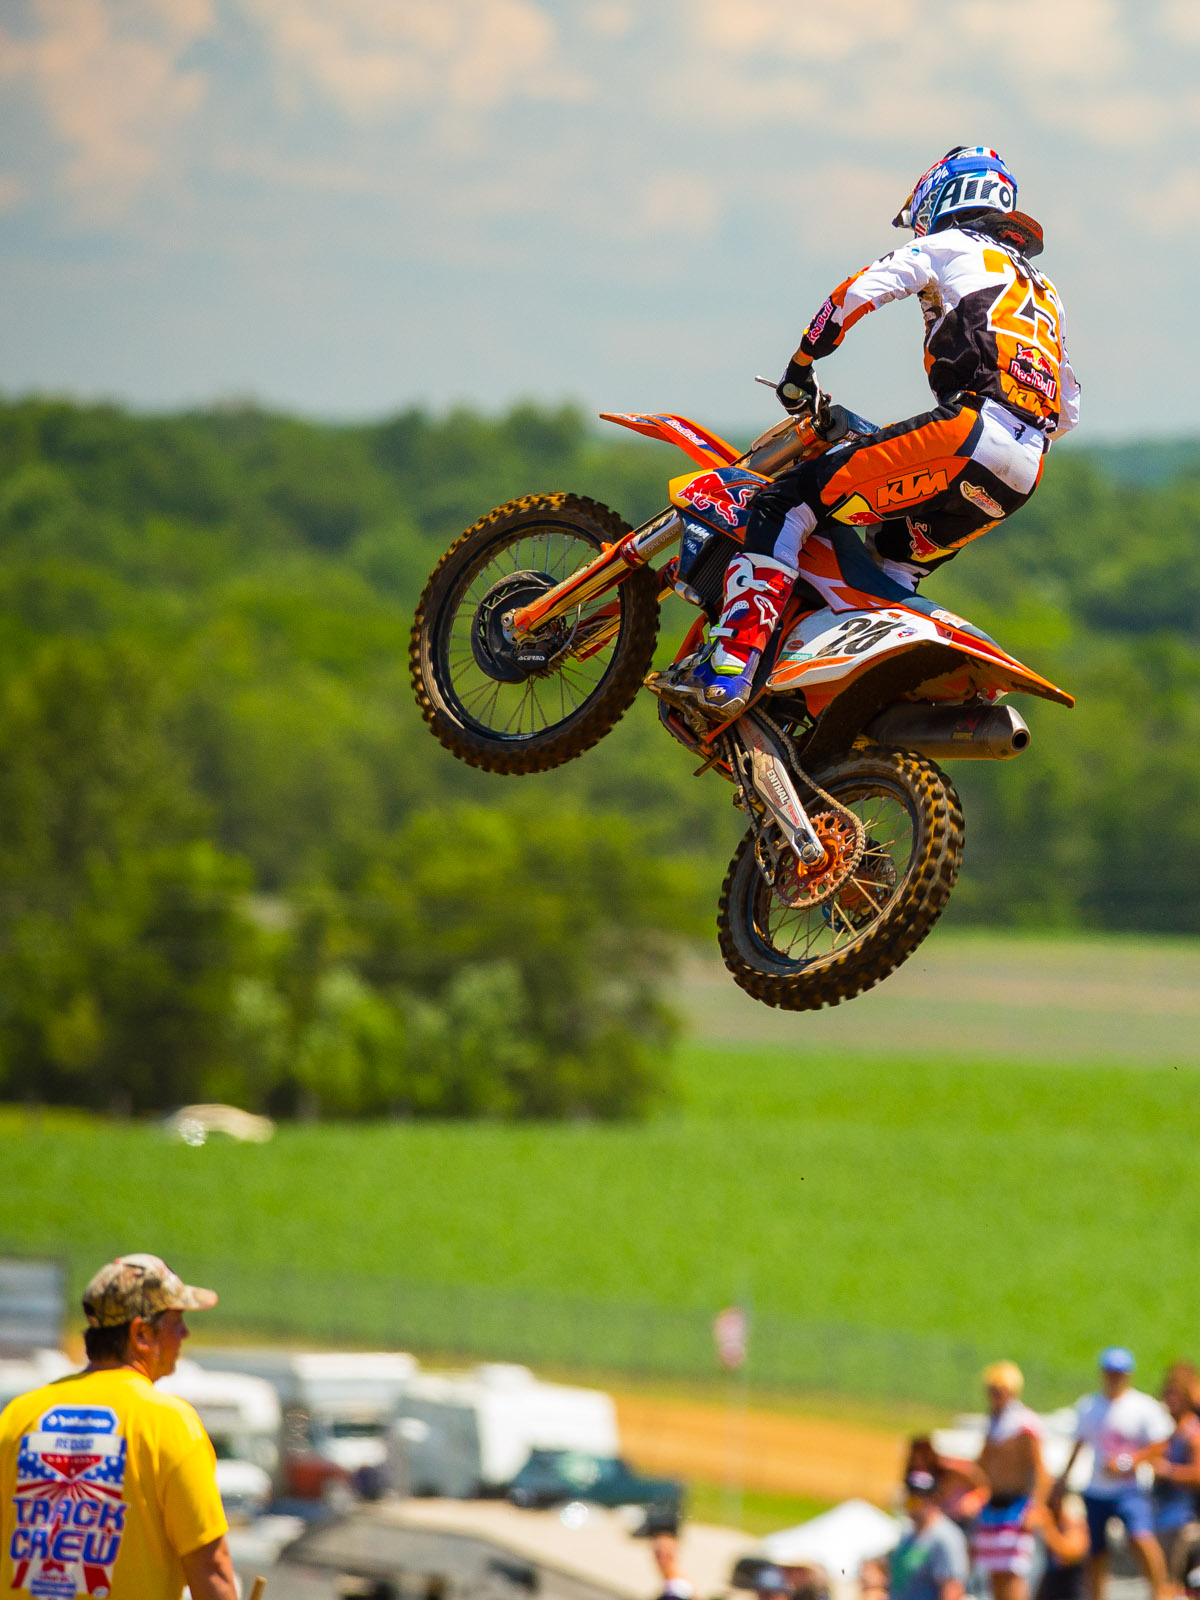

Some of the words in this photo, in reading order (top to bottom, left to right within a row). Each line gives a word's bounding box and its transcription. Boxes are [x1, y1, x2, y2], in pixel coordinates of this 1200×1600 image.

[807, 324, 824, 345] Red
[817, 302, 835, 328] Bull
[1010, 360, 1036, 386] Red
[1034, 371, 1056, 399] Bull
[877, 468, 949, 508] KTM
[687, 523, 710, 540] KTM
